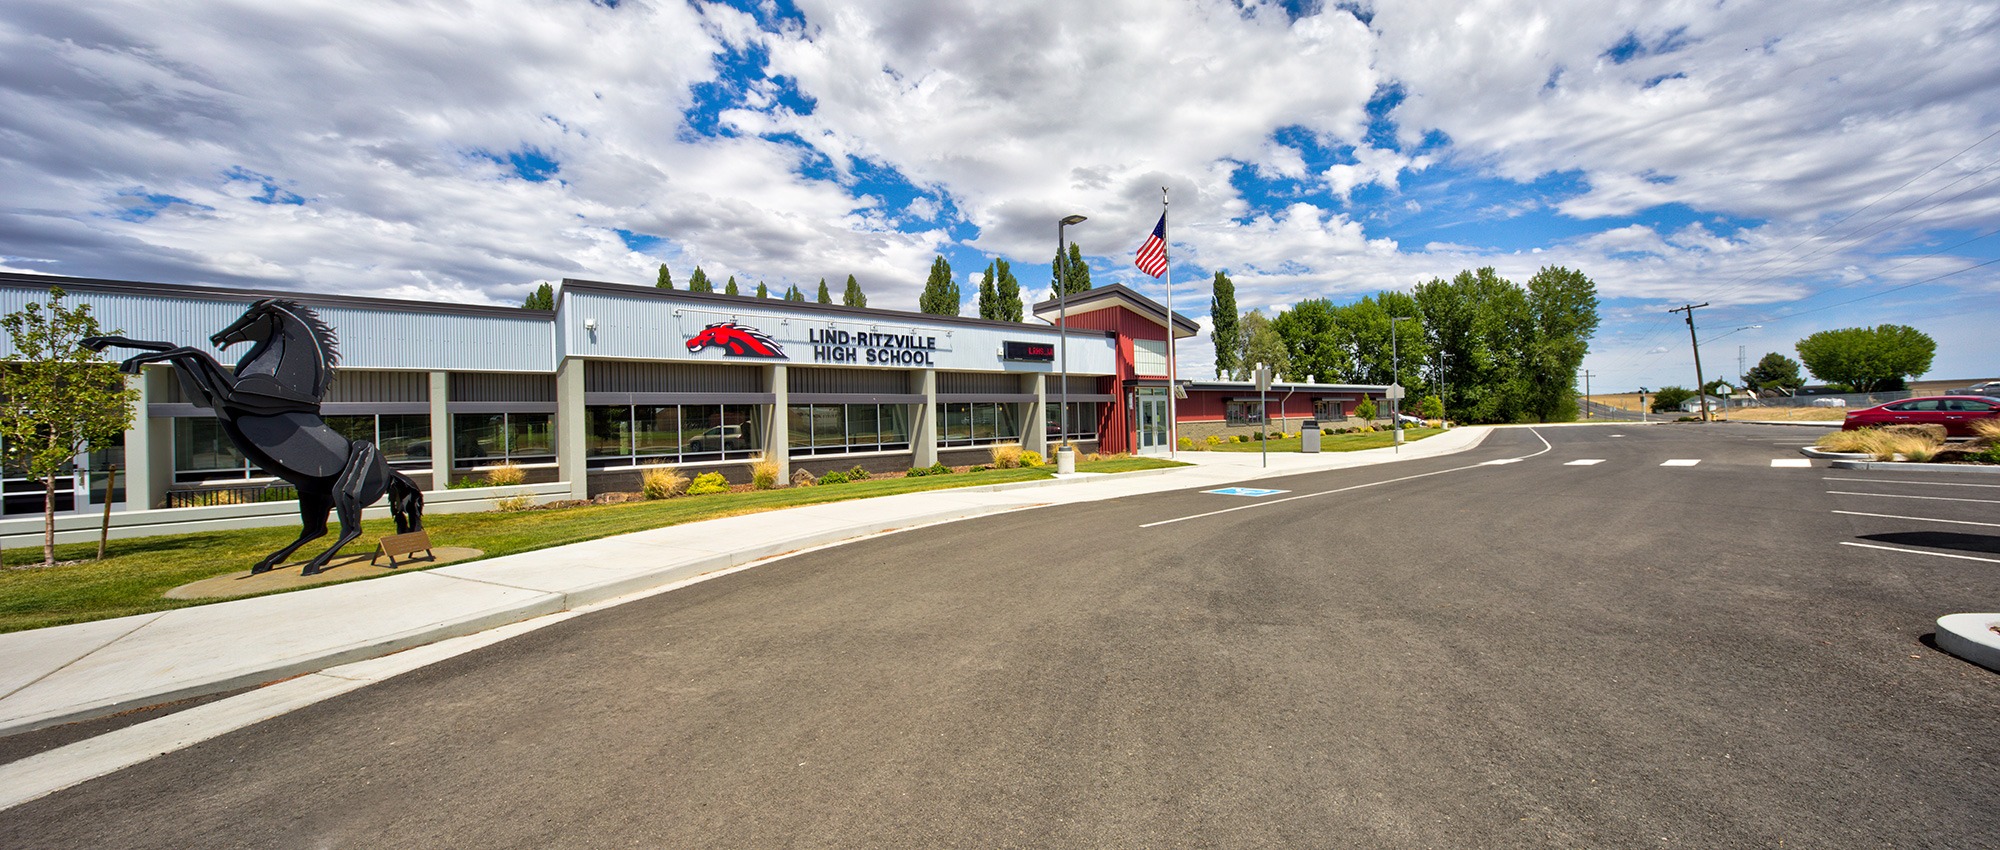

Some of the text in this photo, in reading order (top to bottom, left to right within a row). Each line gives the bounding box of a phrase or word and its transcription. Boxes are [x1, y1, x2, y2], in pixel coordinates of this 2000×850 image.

[809, 328, 936, 349] LIND-RITZVILLE
[814, 345, 934, 365] HIGH SCHOOL
